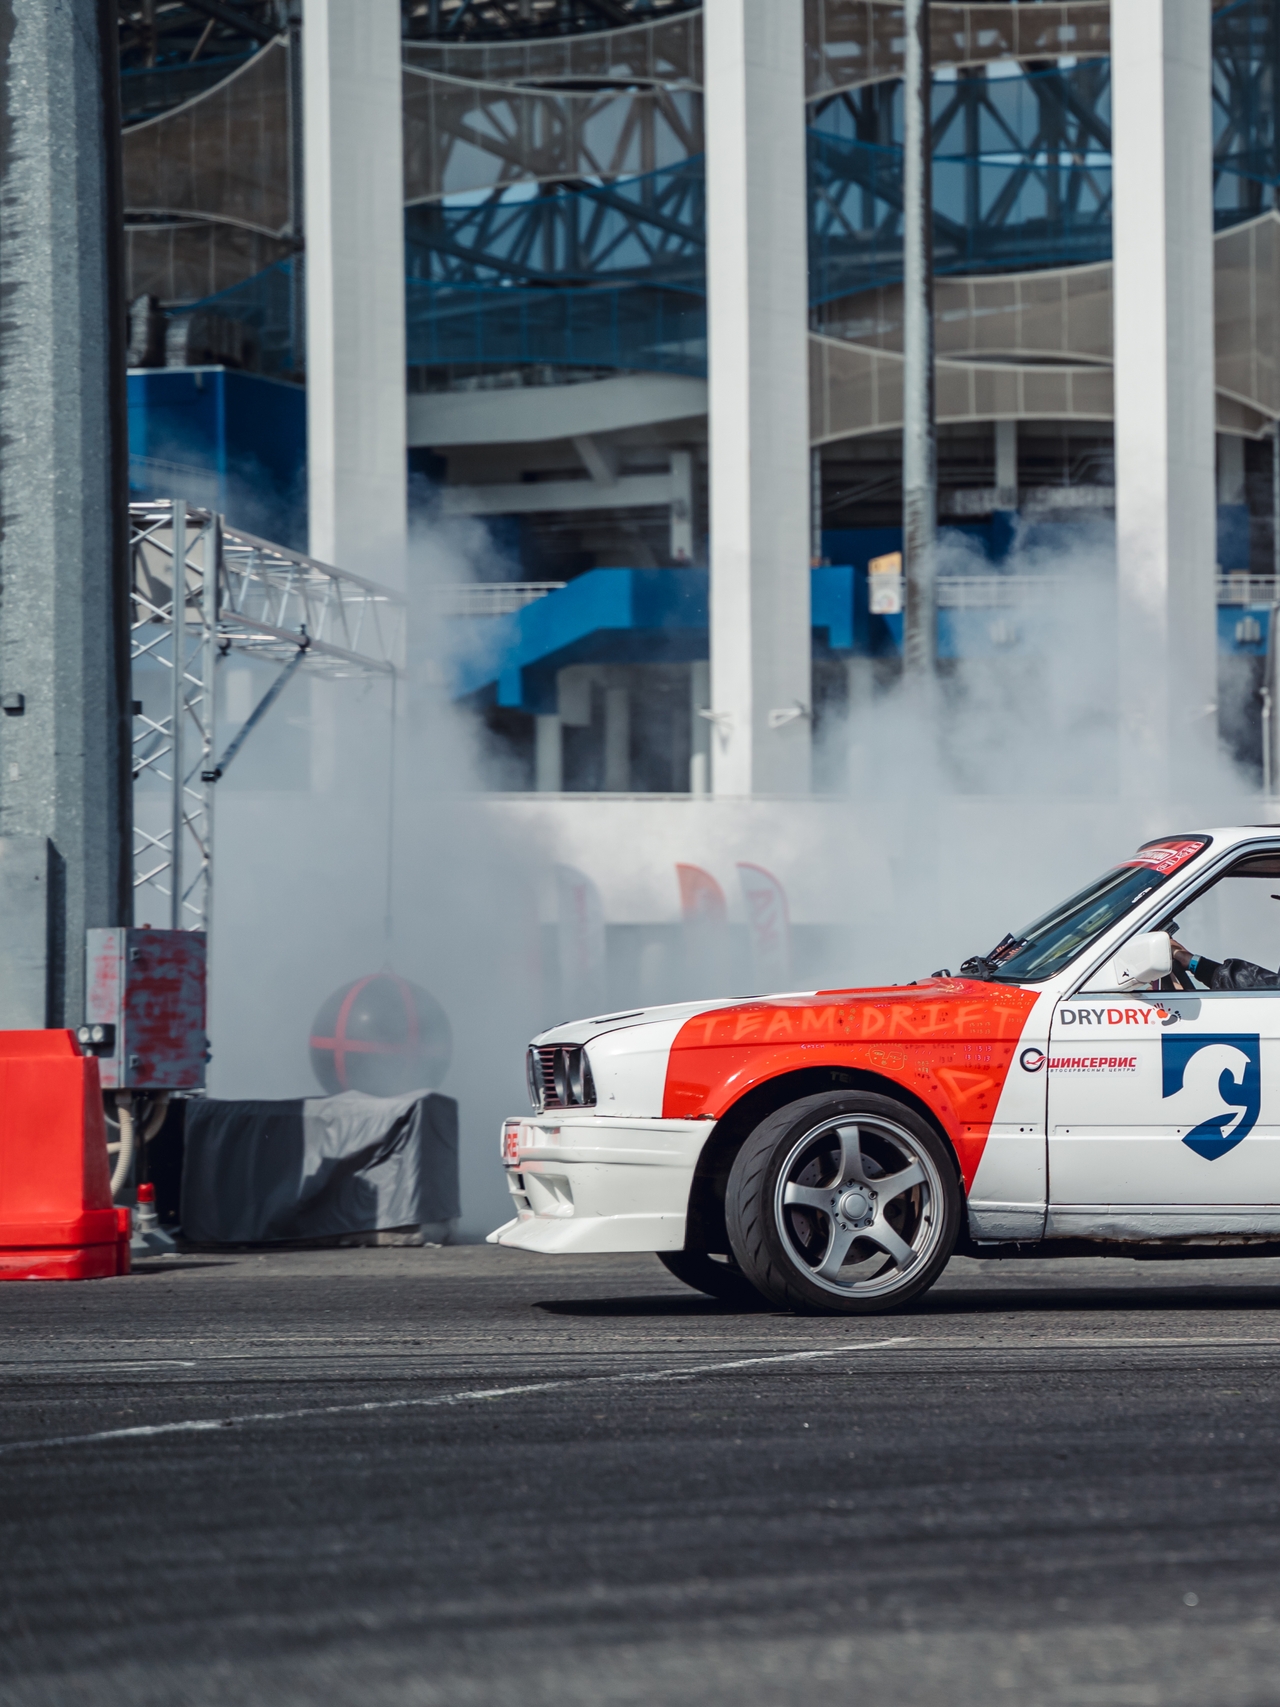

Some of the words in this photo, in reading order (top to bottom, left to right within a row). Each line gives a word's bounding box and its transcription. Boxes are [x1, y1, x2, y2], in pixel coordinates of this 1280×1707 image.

[694, 1005, 838, 1043] TEAM
[860, 1003, 1025, 1040] DRIFT
[1060, 1008, 1151, 1025] DRYDRY
[1047, 1057, 1137, 1069] ШИНСЕРВИС
